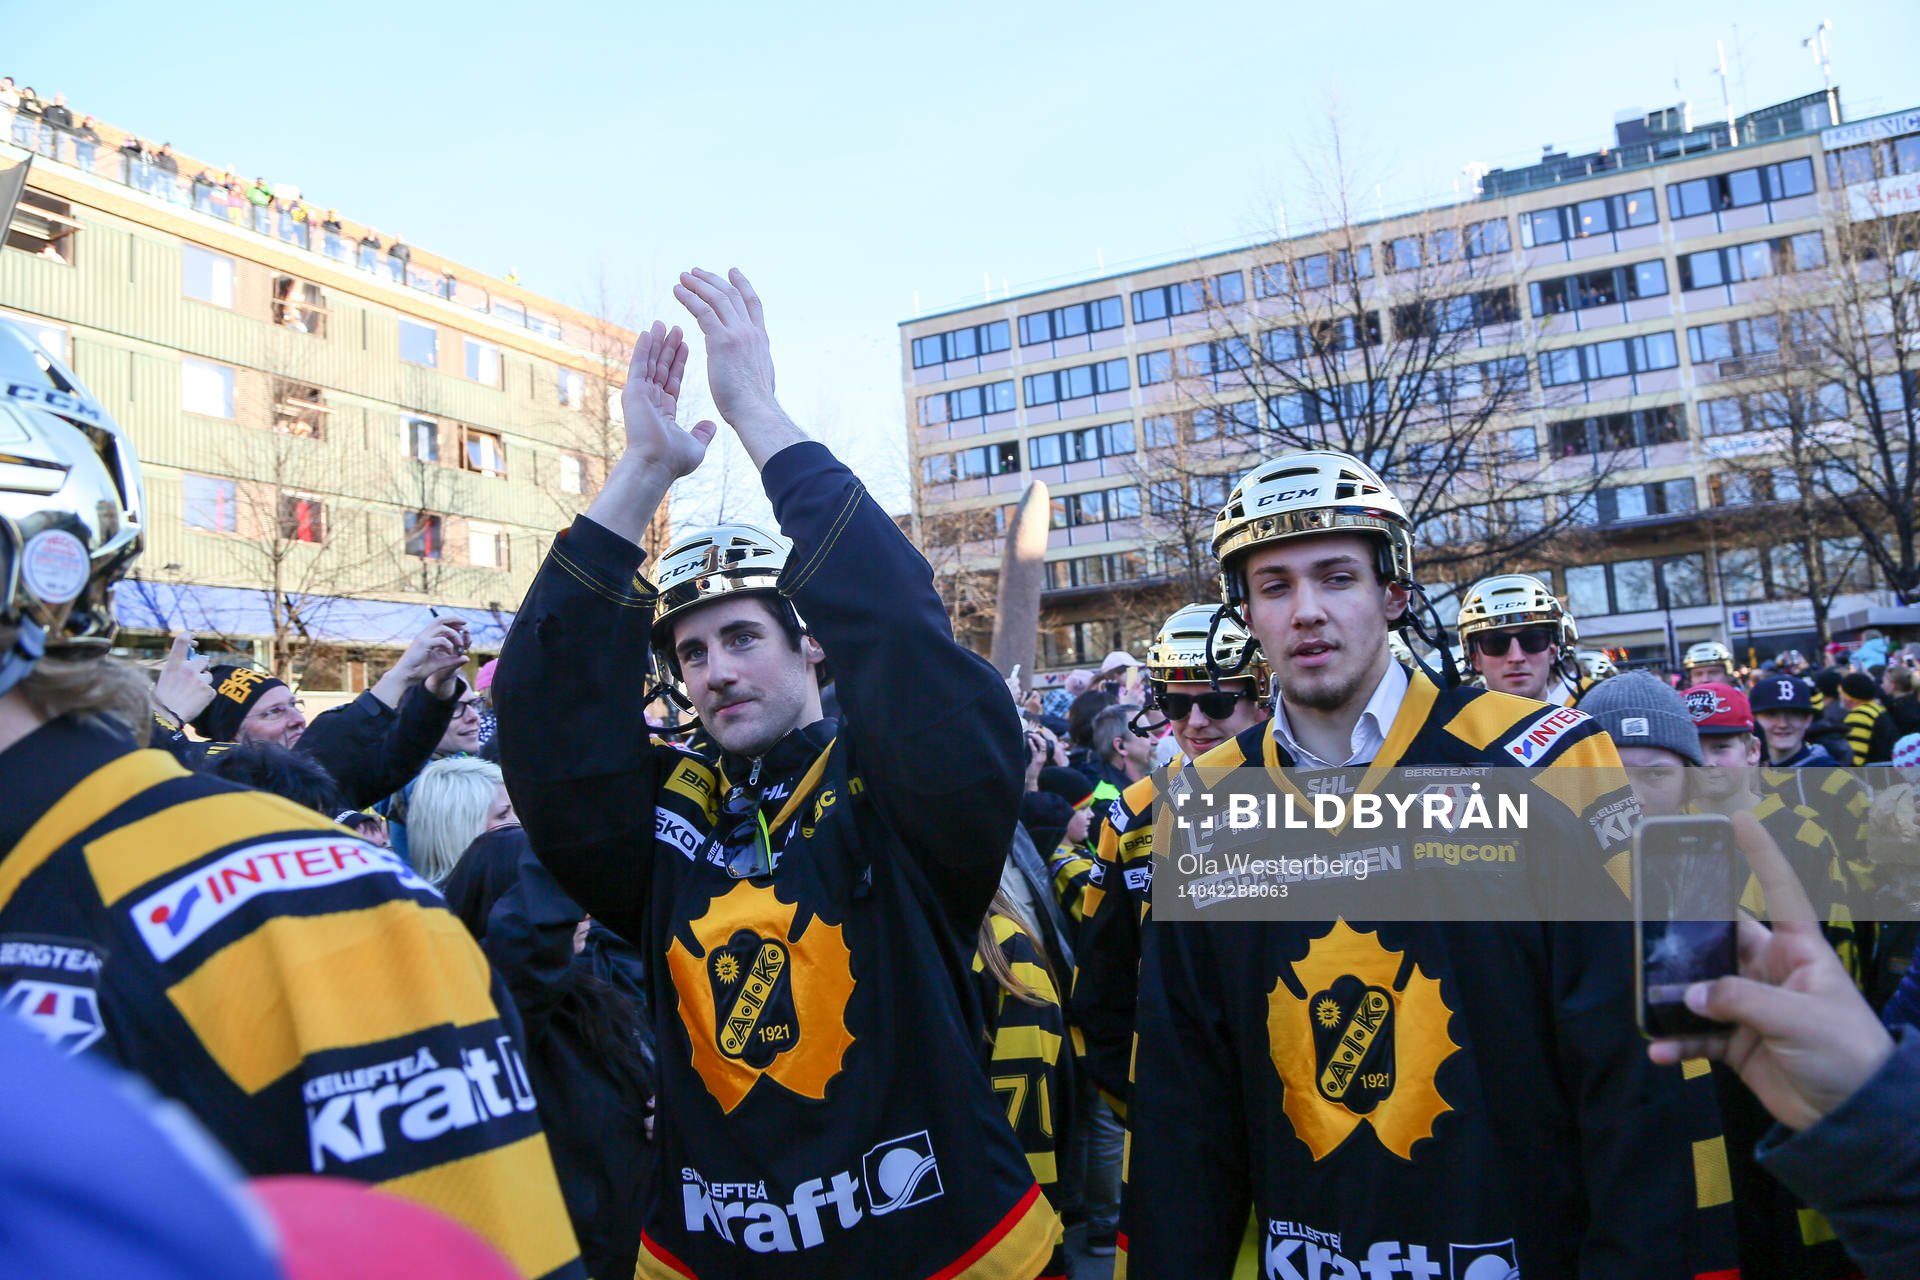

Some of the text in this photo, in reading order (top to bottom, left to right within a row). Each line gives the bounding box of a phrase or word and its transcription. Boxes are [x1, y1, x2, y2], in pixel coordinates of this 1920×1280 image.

[7, 384, 99, 420] CCM
[1257, 487, 1320, 507] CCM
[659, 559, 707, 585] CCM
[1493, 601, 1528, 610] CCM
[1167, 652, 1206, 661] CCM
[1777, 680, 1794, 700] B
[1306, 775, 1356, 798] SHL
[1413, 841, 1517, 865] engcon
[758, 1024, 790, 1043] 1921
[1360, 1073, 1390, 1089] 1921
